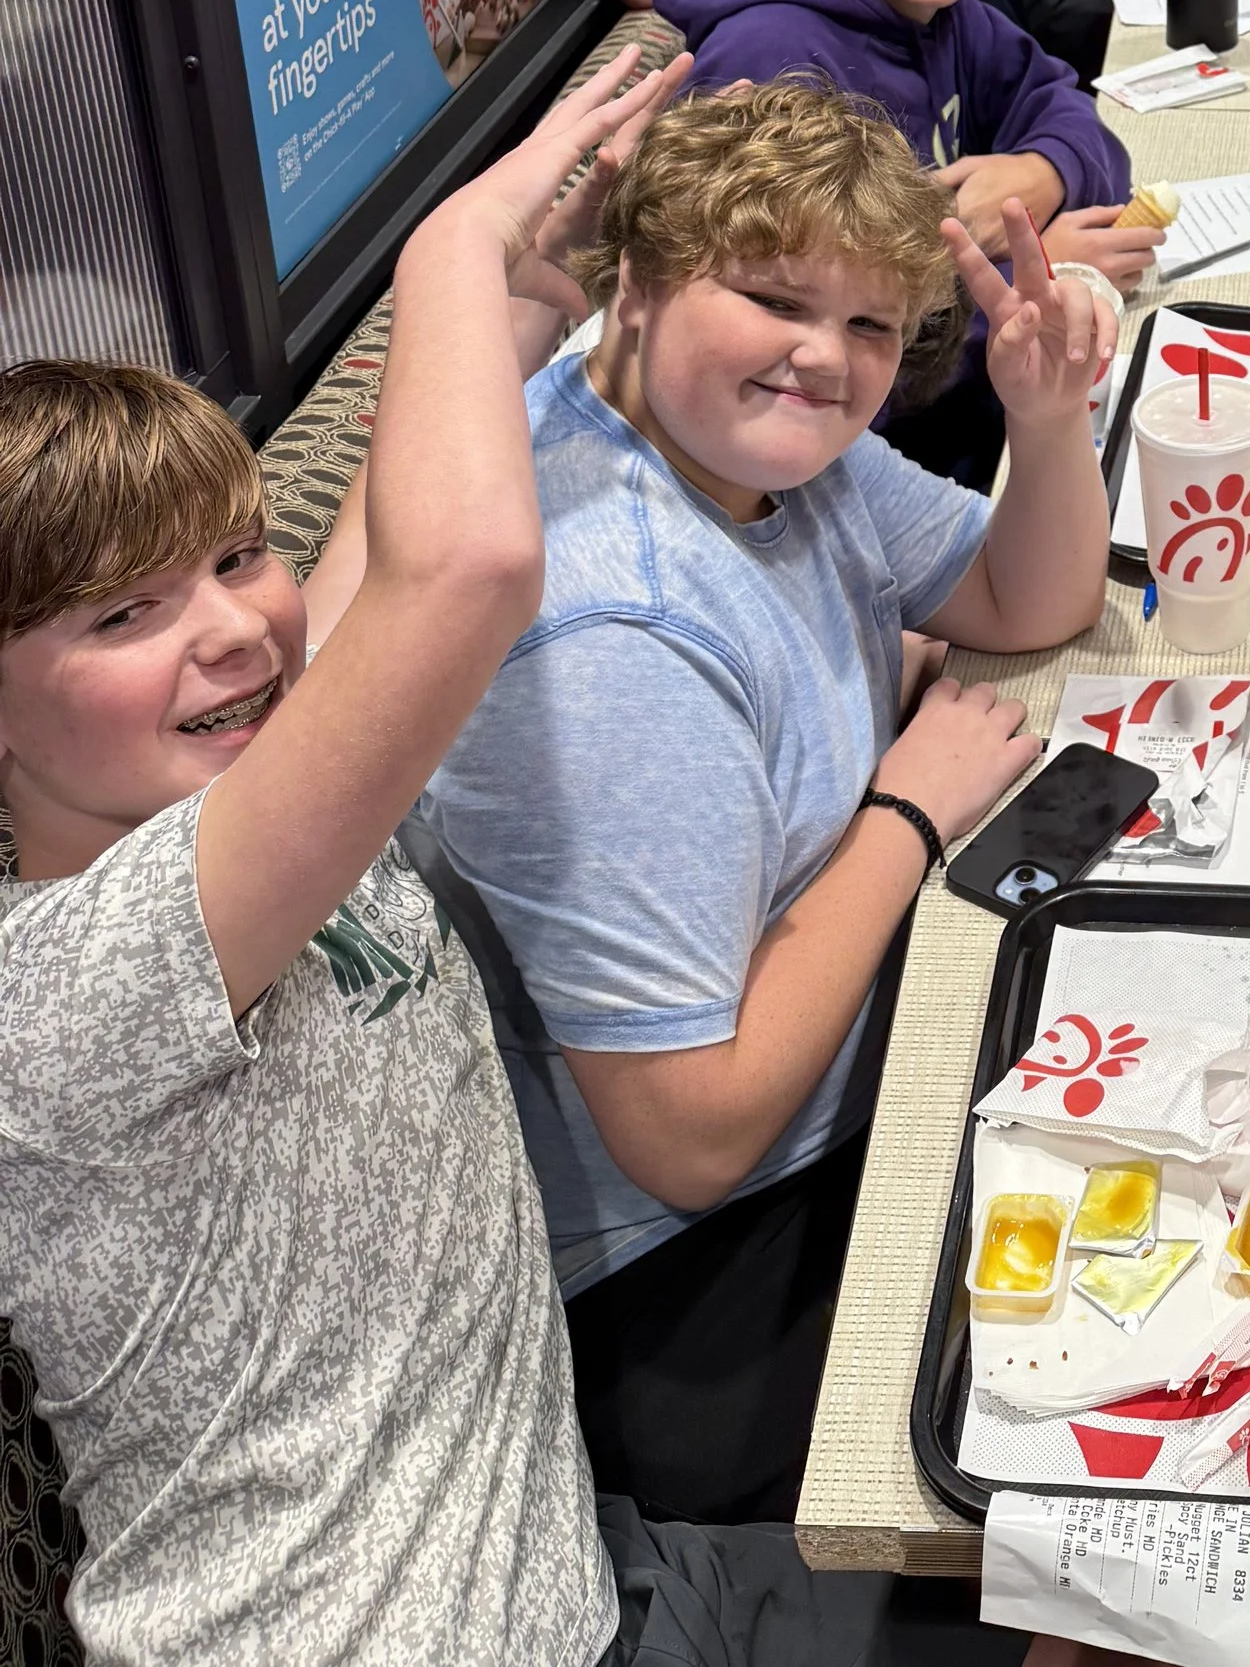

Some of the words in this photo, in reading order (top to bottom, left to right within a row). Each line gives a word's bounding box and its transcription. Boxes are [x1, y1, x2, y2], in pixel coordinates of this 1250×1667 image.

[1078, 1505, 1094, 1533] Coke
[1111, 1500, 1126, 1539] etchup
[1146, 1502, 1159, 1529] ries
[1225, 1519, 1238, 1533] IN
[1060, 1524, 1077, 1570] Orange
[1075, 1541, 1088, 1557] MD
[1090, 1527, 1103, 1543] MD
[1121, 1516, 1138, 1554] Must.
[1143, 1535, 1156, 1551] MD
[1174, 1532, 1189, 1565] Sand
[1159, 1524, 1176, 1586] -Pickles
[1185, 1552, 1200, 1583] 12ct
[1204, 1530, 1223, 1594] SANDWICH
[1232, 1569, 1247, 1602] 8334
